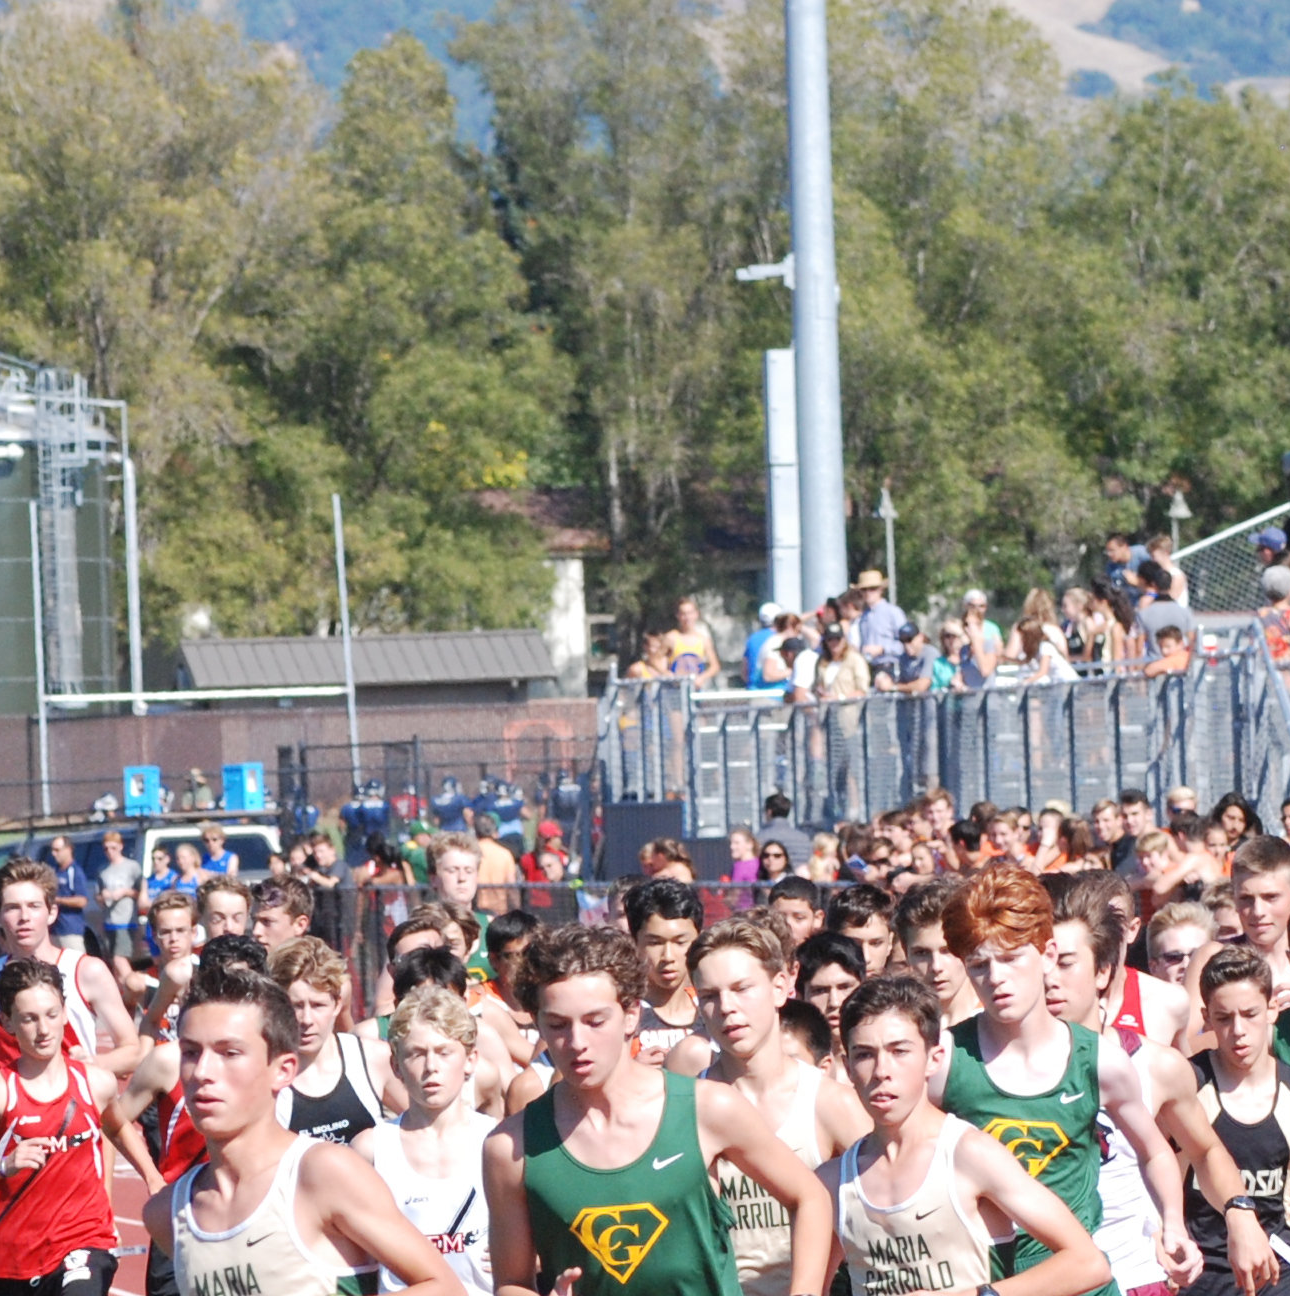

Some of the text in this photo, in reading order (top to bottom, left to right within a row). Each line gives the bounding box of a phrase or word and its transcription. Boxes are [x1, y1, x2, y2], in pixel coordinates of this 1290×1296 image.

[312, 1119, 350, 1135] MOLINO
[867, 1233, 932, 1267] MARIA
[865, 1260, 955, 1296] CARRILLO
